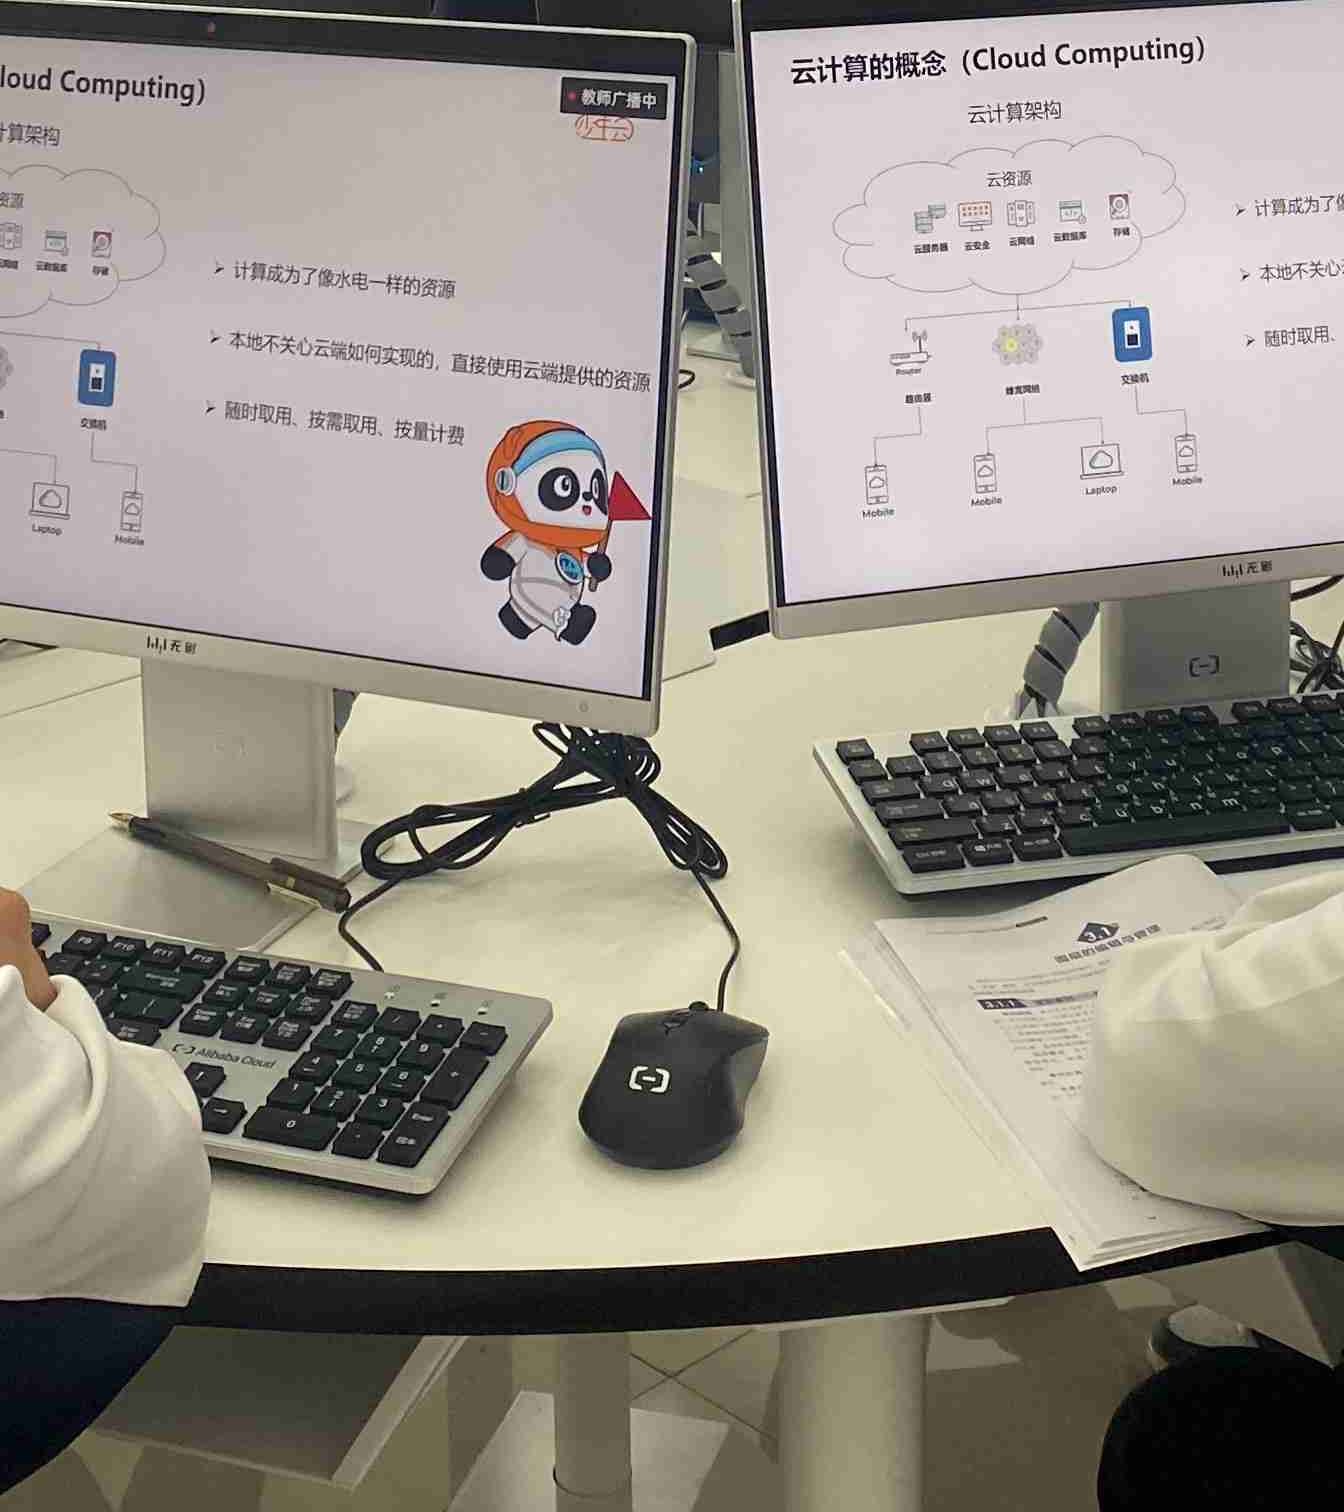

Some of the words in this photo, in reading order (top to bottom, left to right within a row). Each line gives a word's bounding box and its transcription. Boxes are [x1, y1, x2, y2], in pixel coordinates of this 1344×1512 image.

[791, 50, 946, 84] 云计算的概念
[581, 88, 656, 109] 教师广播中
[968, 100, 1062, 124] 云计算架构
[986, 170, 1033, 188] 云资源
[234, 262, 456, 299] 计算成为了像水电一样的资源
[1172, 475, 1203, 486] Mobile
[1085, 484, 1117, 497] Laptop
[970, 495, 1002, 508] Mobile
[862, 507, 894, 520] Mobile
[32, 524, 62, 536] Laptop
[195, 1048, 240, 1064] Alibaba
[241, 1055, 277, 1069] Cloud
